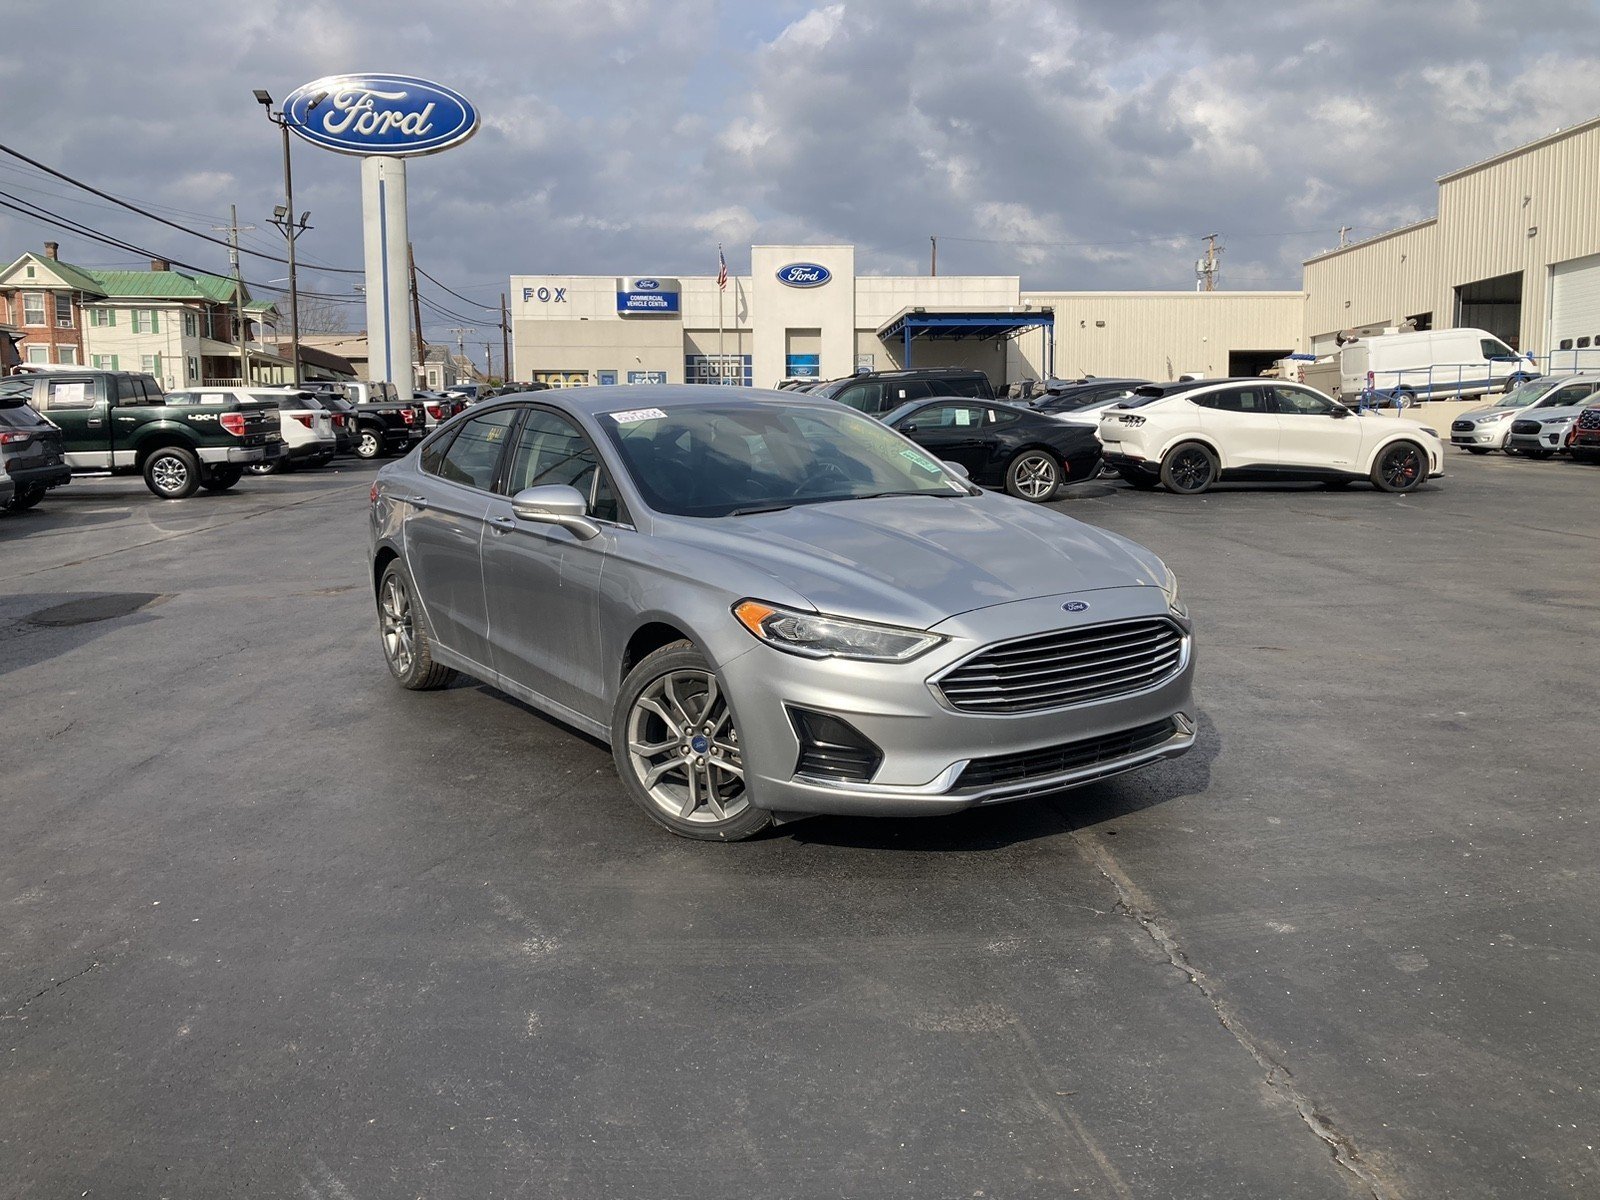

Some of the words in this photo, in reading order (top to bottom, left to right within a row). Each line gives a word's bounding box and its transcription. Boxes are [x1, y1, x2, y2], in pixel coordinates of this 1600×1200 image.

[322, 88, 435, 136] Ford
[787, 267, 819, 282] Ford
[639, 280, 655, 288] Ford
[523, 287, 567, 303] FOX
[699, 362, 739, 376] BULT
[1067, 602, 1084, 611] Ford
